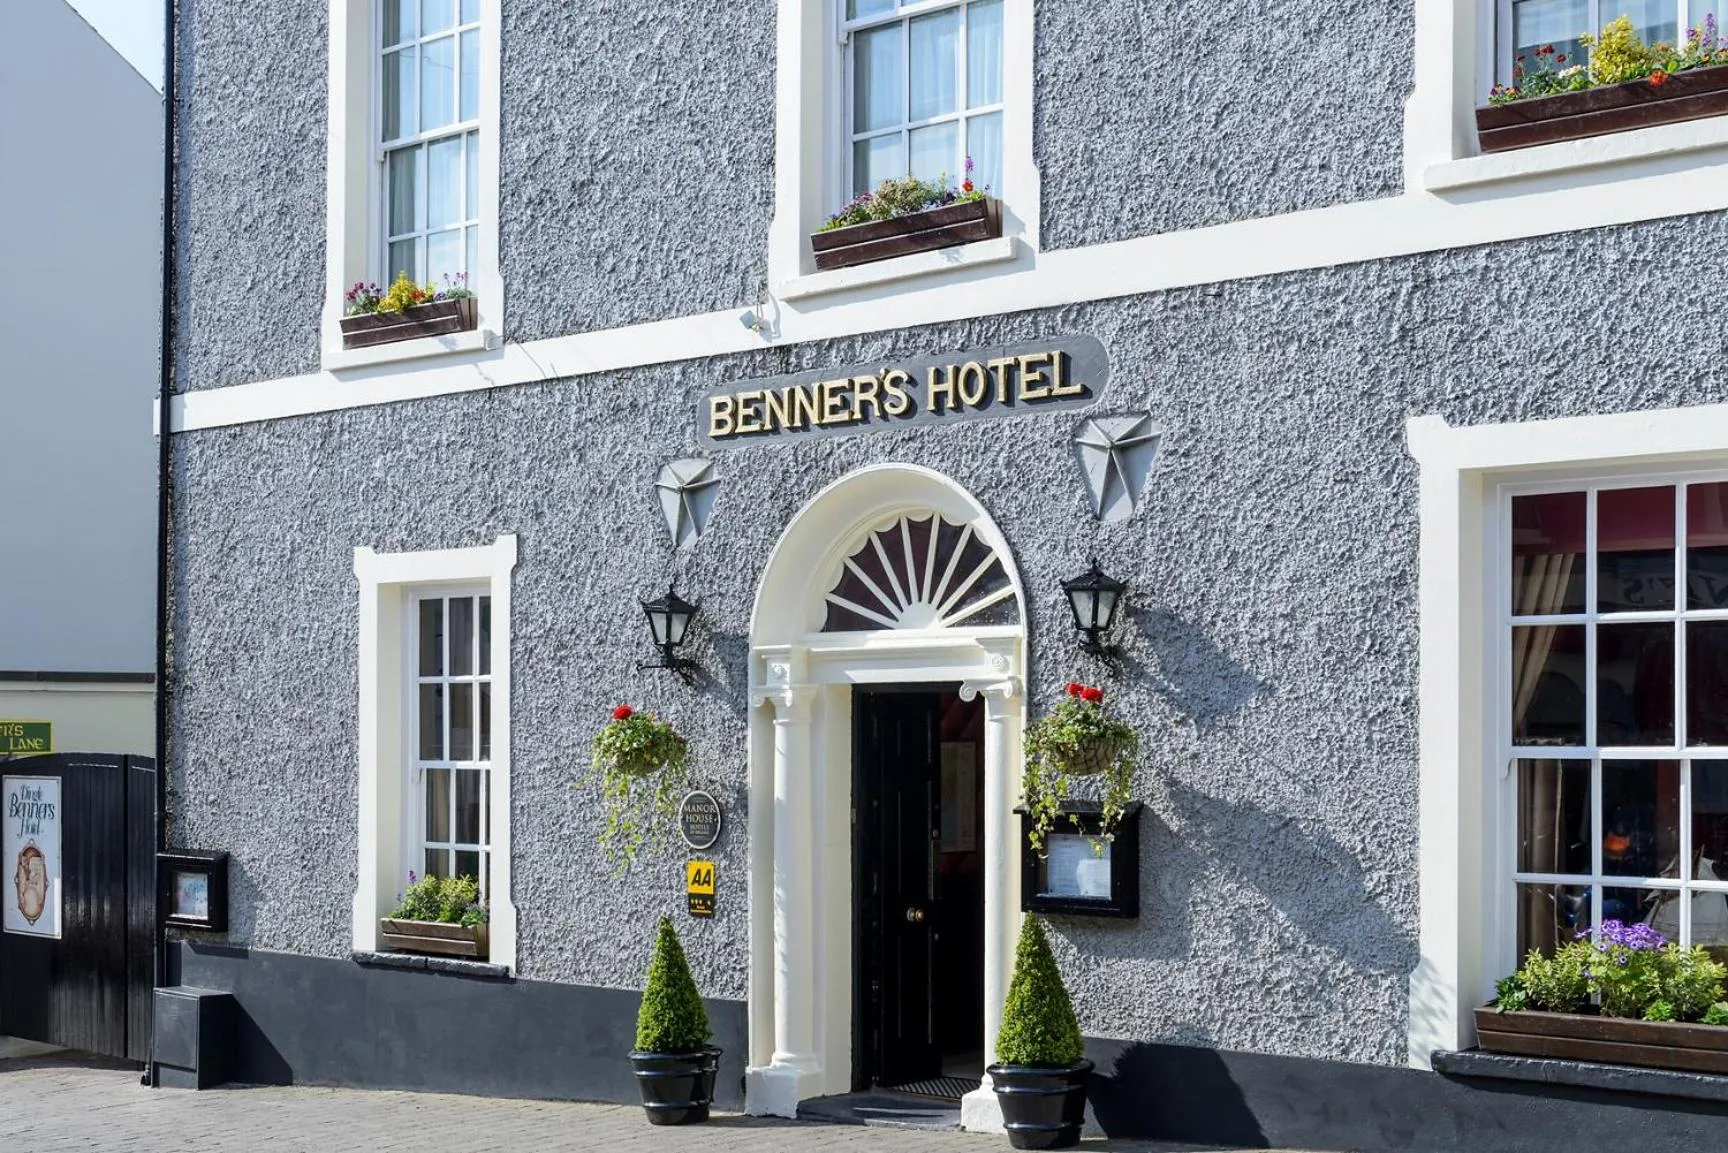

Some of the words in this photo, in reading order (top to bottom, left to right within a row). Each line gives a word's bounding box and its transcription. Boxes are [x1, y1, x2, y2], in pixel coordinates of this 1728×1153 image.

[707, 368, 913, 438] BENNER'S
[926, 349, 1086, 412] HOTEL
[9, 736, 44, 750] LANE
[683, 804, 716, 813] MANOR
[686, 814, 713, 823] HOUSE
[690, 868, 712, 887] AA
